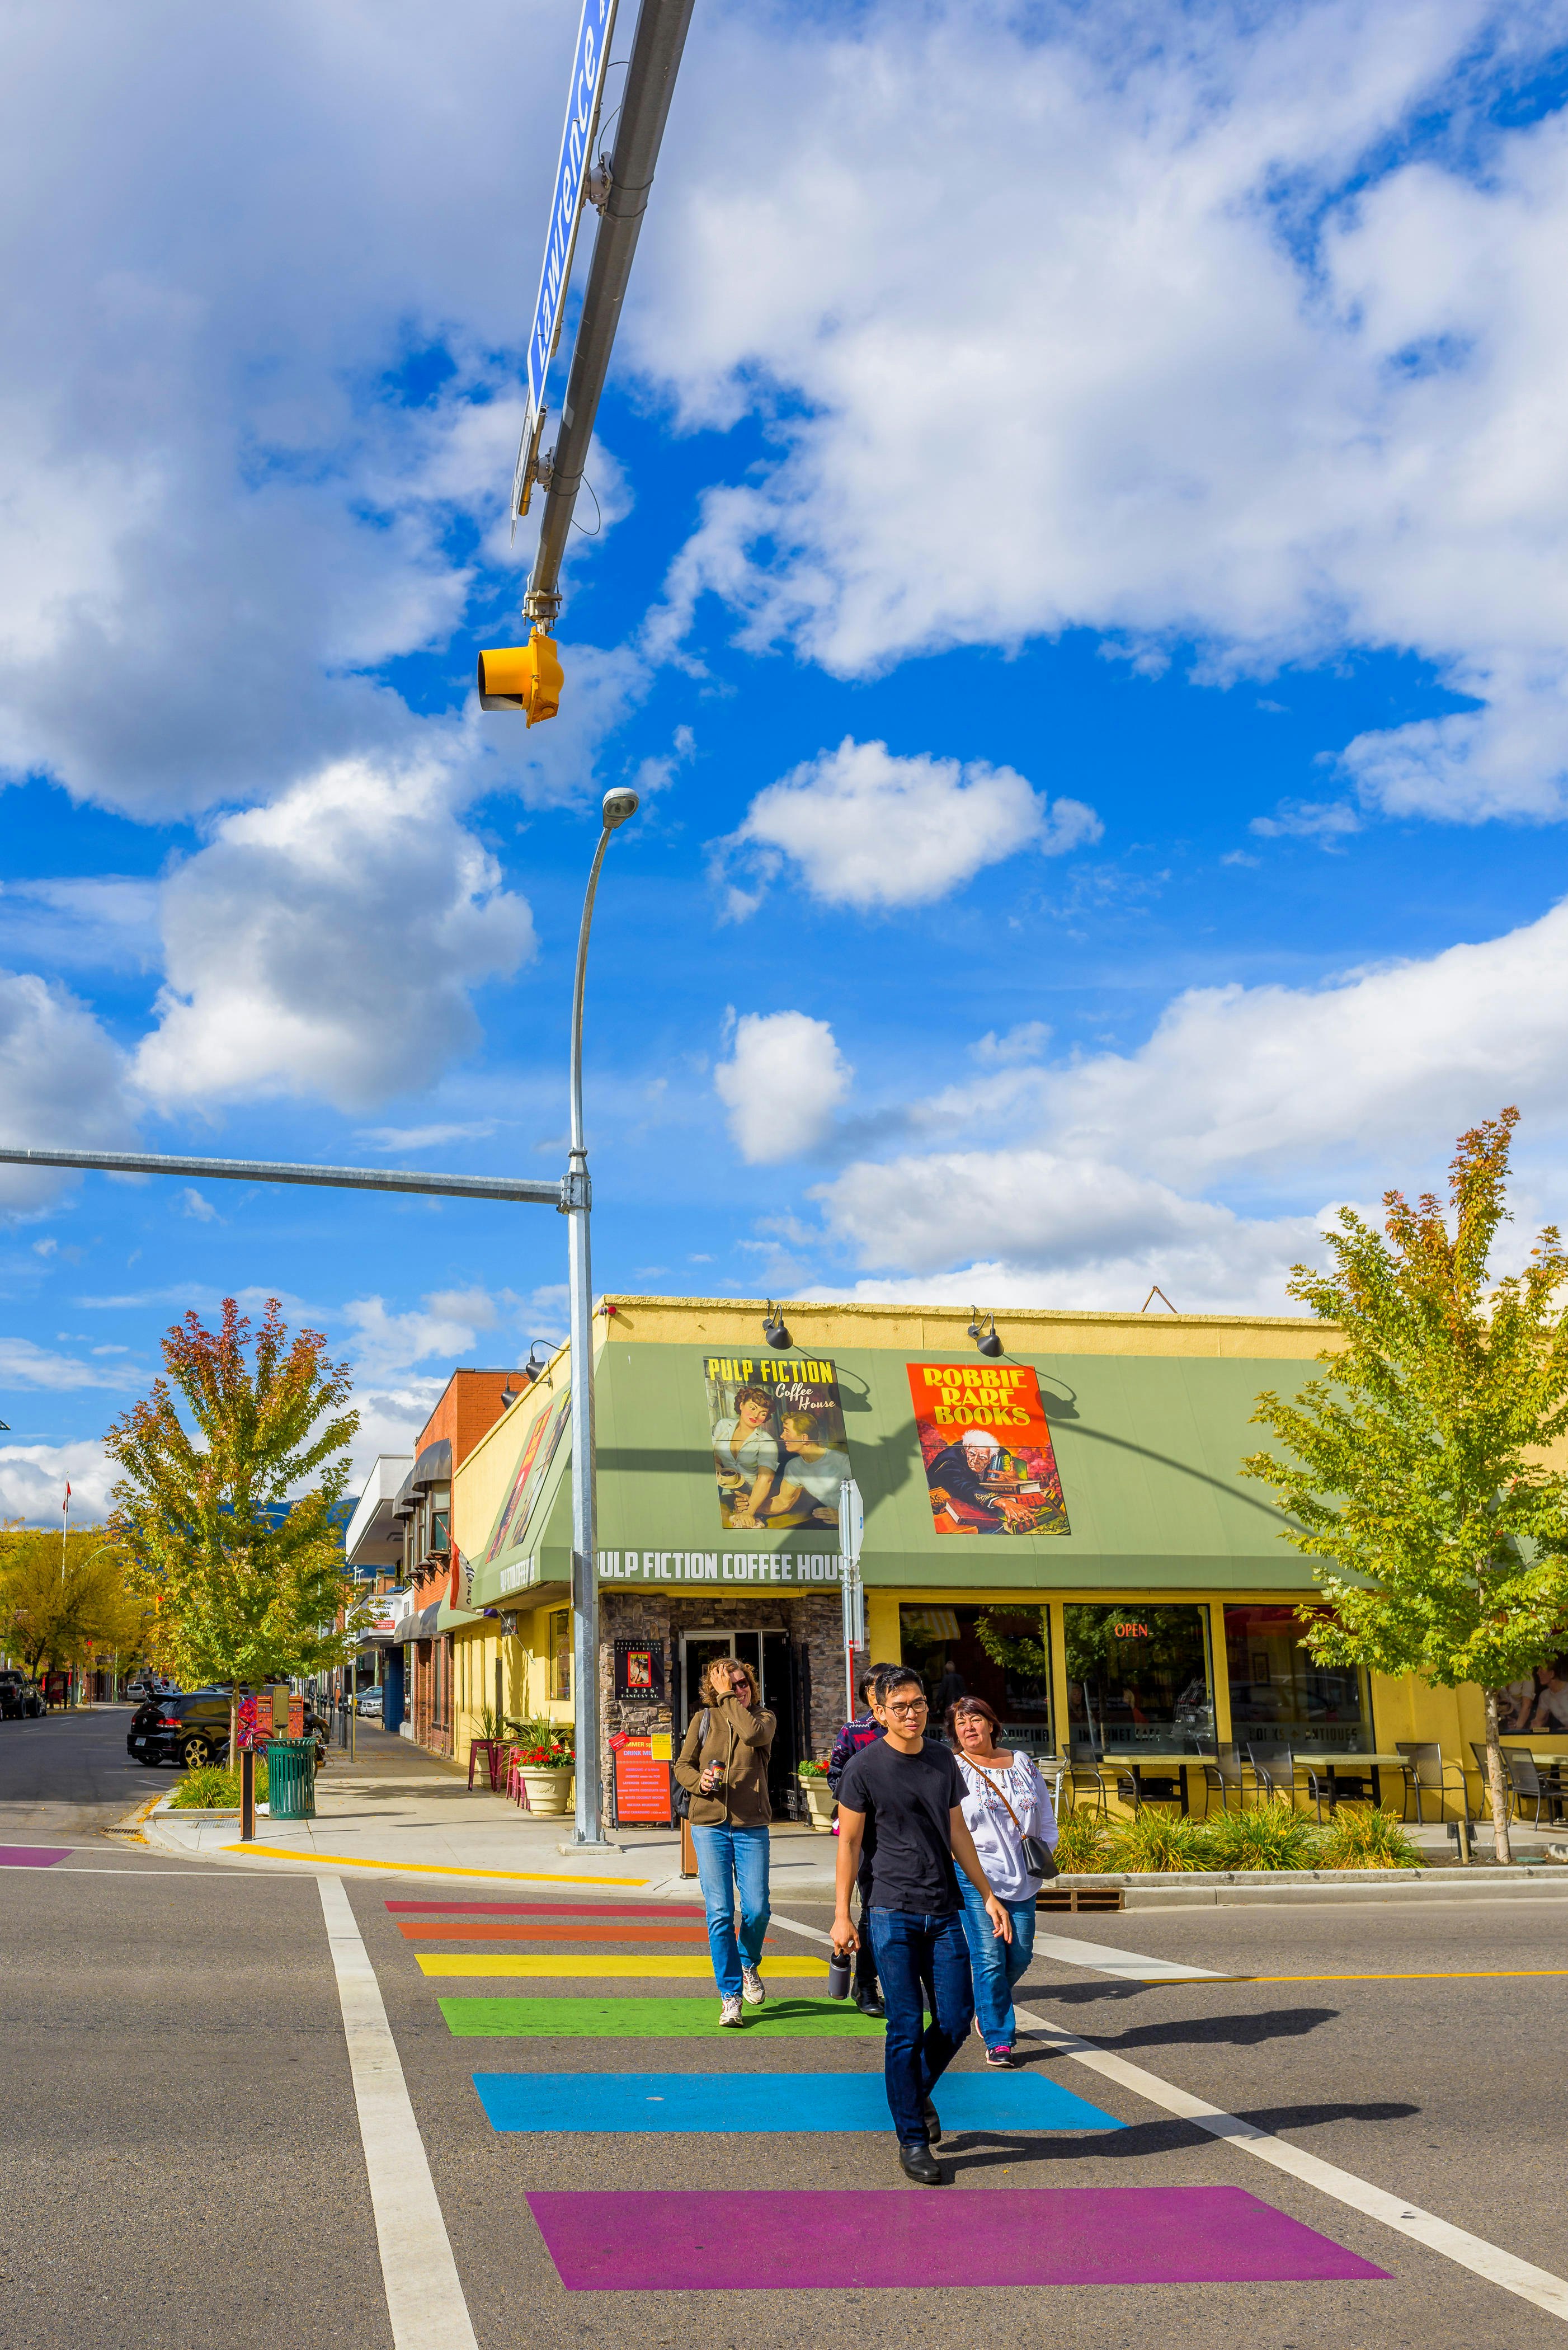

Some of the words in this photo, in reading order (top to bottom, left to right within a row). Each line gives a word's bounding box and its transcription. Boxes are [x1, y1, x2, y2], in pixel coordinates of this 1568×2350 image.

[537, 25, 596, 373] Lawrence
[708, 1359, 754, 1381] PULP
[760, 1360, 834, 1384] FICTION
[923, 1368, 1028, 1388] ROBBIE
[775, 1382, 813, 1402] Coffee
[941, 1387, 1017, 1407] RARE
[798, 1395, 836, 1411] House
[934, 1406, 1031, 1426] BOOKS
[597, 1551, 638, 1578] ULP
[643, 1552, 718, 1579] FICTION
[722, 1553, 793, 1580] COFFEE
[1114, 1623, 1147, 1637] OPEN
[1078, 1728, 1131, 1742] INERNET
[1305, 1728, 1358, 1741] ANTIQUES
